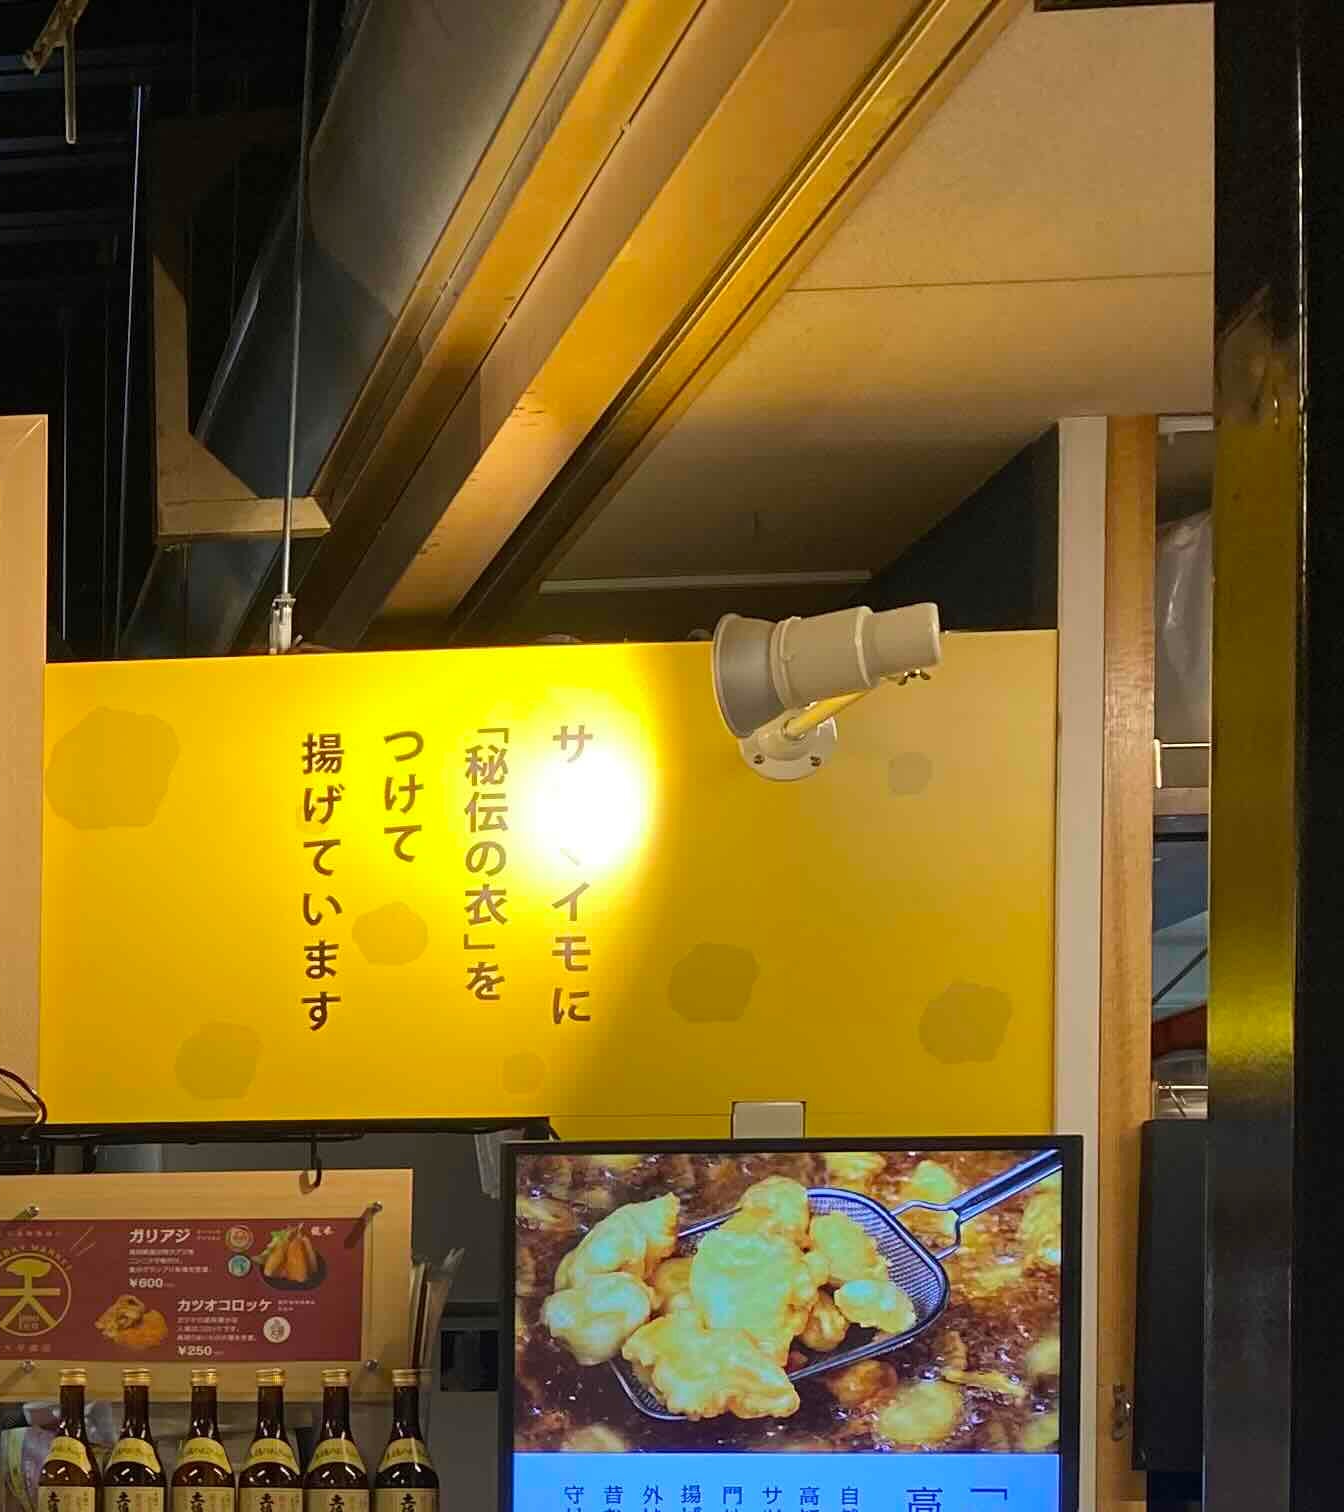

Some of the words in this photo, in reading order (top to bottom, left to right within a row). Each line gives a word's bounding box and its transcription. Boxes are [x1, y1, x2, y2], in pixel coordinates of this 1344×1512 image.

[382, 728, 424, 863] つけて
[301, 733, 345, 1032] 揚げています
[464, 725, 509, 1003] 「秘伝の衣」を
[129, 1228, 192, 1245] ガリアジ
[176, 1299, 273, 1313] カツオコロッケ
